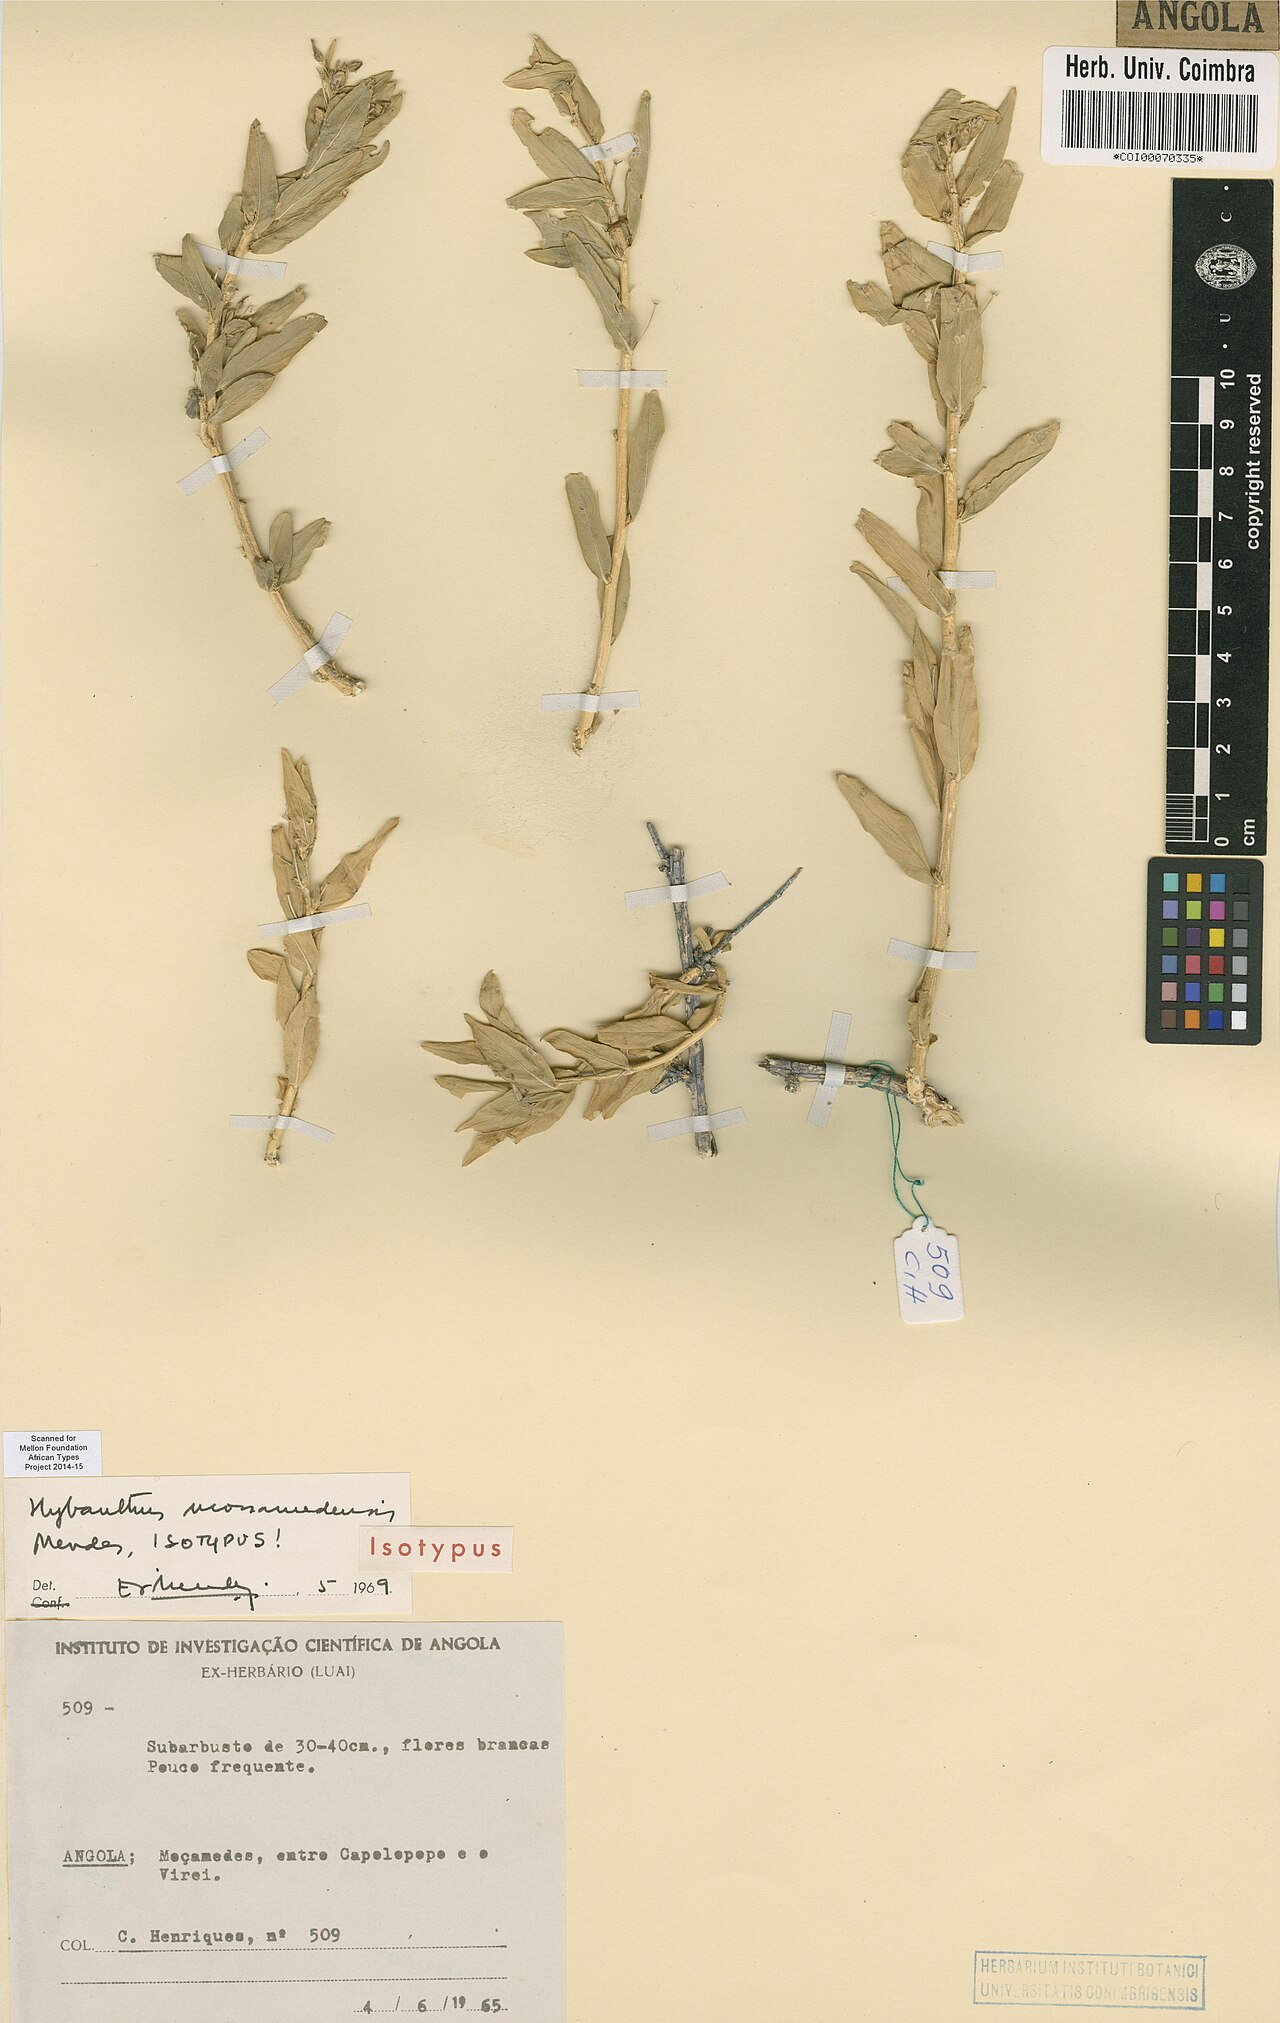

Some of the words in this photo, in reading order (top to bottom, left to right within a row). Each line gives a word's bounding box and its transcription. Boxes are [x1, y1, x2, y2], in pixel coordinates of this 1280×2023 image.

[1132, 0, 1265, 33] ANGOLA
[1067, 54, 1114, 78] Herb.
[1124, 56, 1170, 80] Univ.
[1180, 57, 1254, 82] Coimbra
[1220, 369, 1235, 389] 10
[1246, 374, 1261, 454] reserved
[1220, 420, 1234, 429] 9
[1219, 467, 1234, 476] 8
[1245, 461, 1264, 549] copyright
[1219, 512, 1233, 521] 7
[1218, 559, 1233, 569] 6
[1218, 606, 1232, 615] 5
[1217, 652, 1231, 662] 4
[1216, 698, 1231, 707] 3
[1216, 744, 1230, 754] 2
[1244, 819, 1255, 846] cm
[1214, 837, 1229, 846] 0
[927, 1243, 954, 1300] 509
[57, 1454, 79, 1462] Types
[371, 1537, 500, 1562] Isotypus
[33, 1580, 55, 1590] Det.
[56, 1641, 140, 1654] INSTITUTO
[148, 1641, 167, 1653] DE
[175, 1636, 298, 1655] INVESTIGAÇÃO
[305, 1635, 393, 1652] CIENTÍFICA
[402, 1638, 421, 1651] DE
[430, 1637, 500, 1650] ANGOLA
[202, 1664, 303, 1678] EX-HERBÁRIO
[311, 1666, 355, 1679] (LUAI)
[63, 1701, 92, 1715] 509
[265, 1740, 283, 1752] de
[402, 1739, 464, 1751] flores
[211, 1760, 314, 1776] frequente.
[63, 1850, 134, 1867] ANGOLA;
[159, 1849, 262, 1865] Moçamedes,
[160, 1868, 220, 1881] Virei.
[118, 1930, 136, 1943] C.
[150, 1930, 253, 1945] Henriques,
[310, 1928, 340, 1943] 509
[61, 1940, 96, 1952] COL.
[417, 1999, 427, 2013] 6
